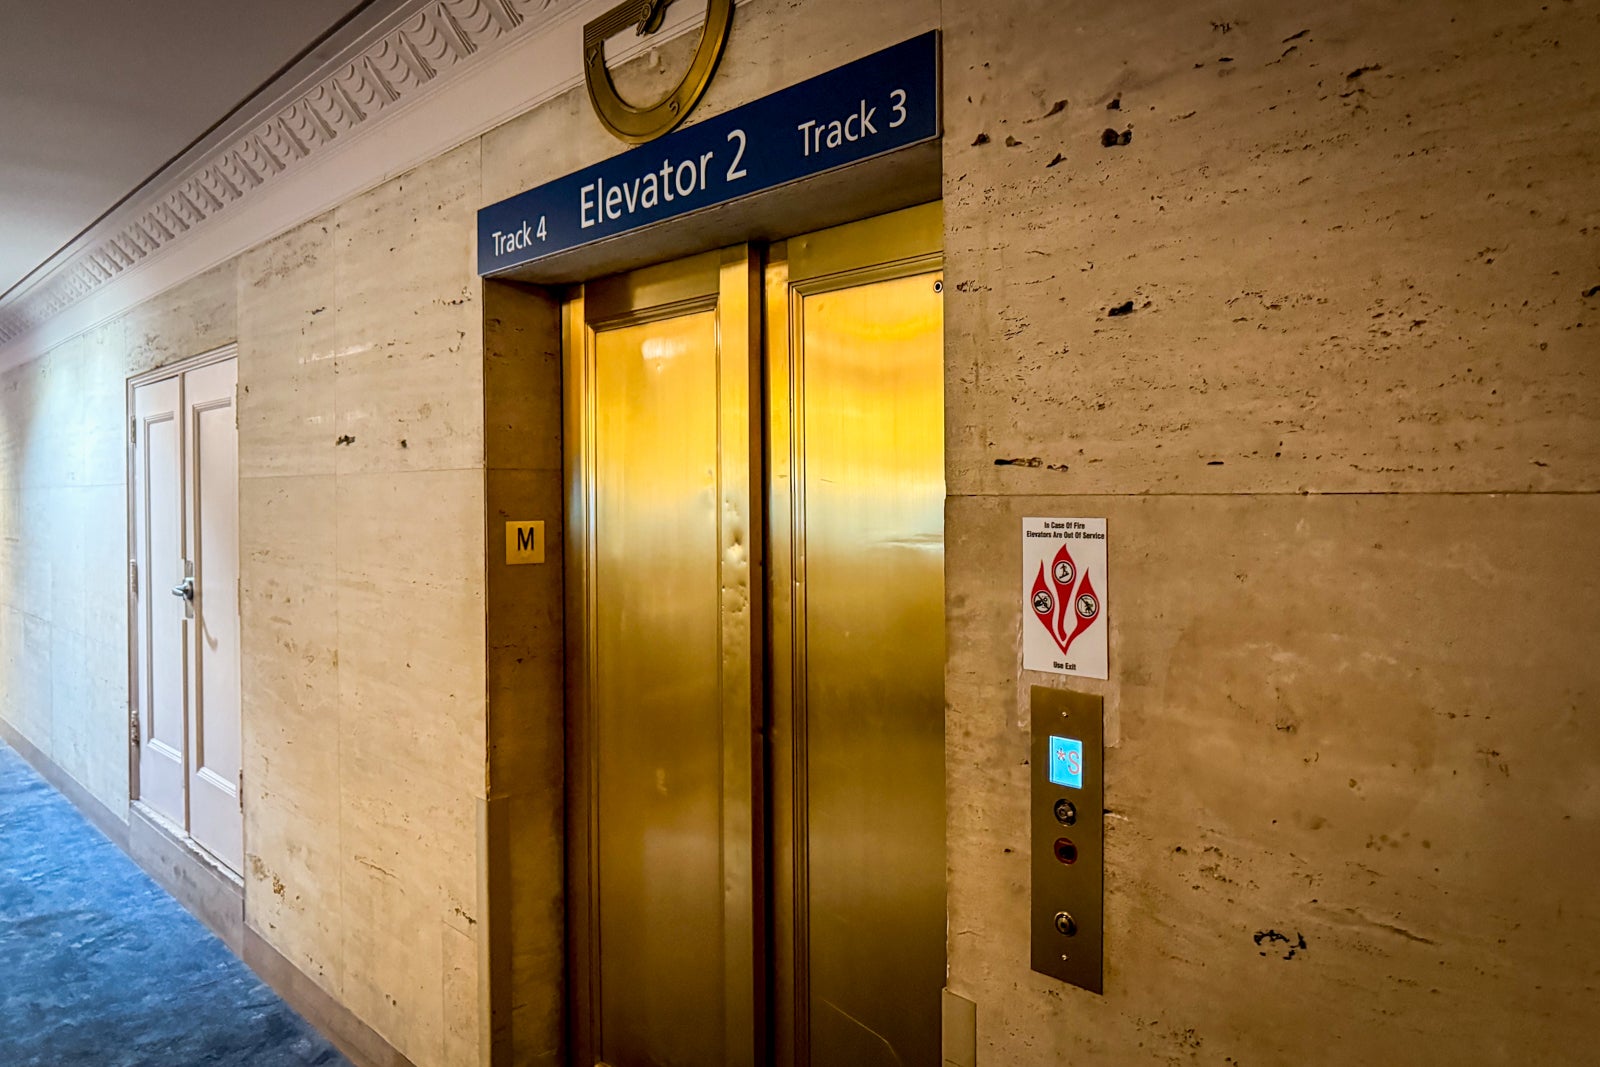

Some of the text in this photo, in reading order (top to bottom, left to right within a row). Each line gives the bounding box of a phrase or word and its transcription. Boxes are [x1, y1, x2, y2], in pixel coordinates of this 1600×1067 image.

[797, 88, 907, 157] Track 3
[580, 128, 748, 229] Elevator 2
[491, 215, 547, 257] Track 4
[1026, 530, 1052, 538] Elevators
[1053, 531, 1063, 539] Are
[1064, 531, 1074, 539] Out
[1082, 532, 1105, 540] Service
[1044, 521, 1050, 529] In
[1051, 521, 1065, 529] Case
[1073, 522, 1085, 530] Fire
[517, 527, 535, 551] M
[1053, 661, 1077, 670] Use Exit
